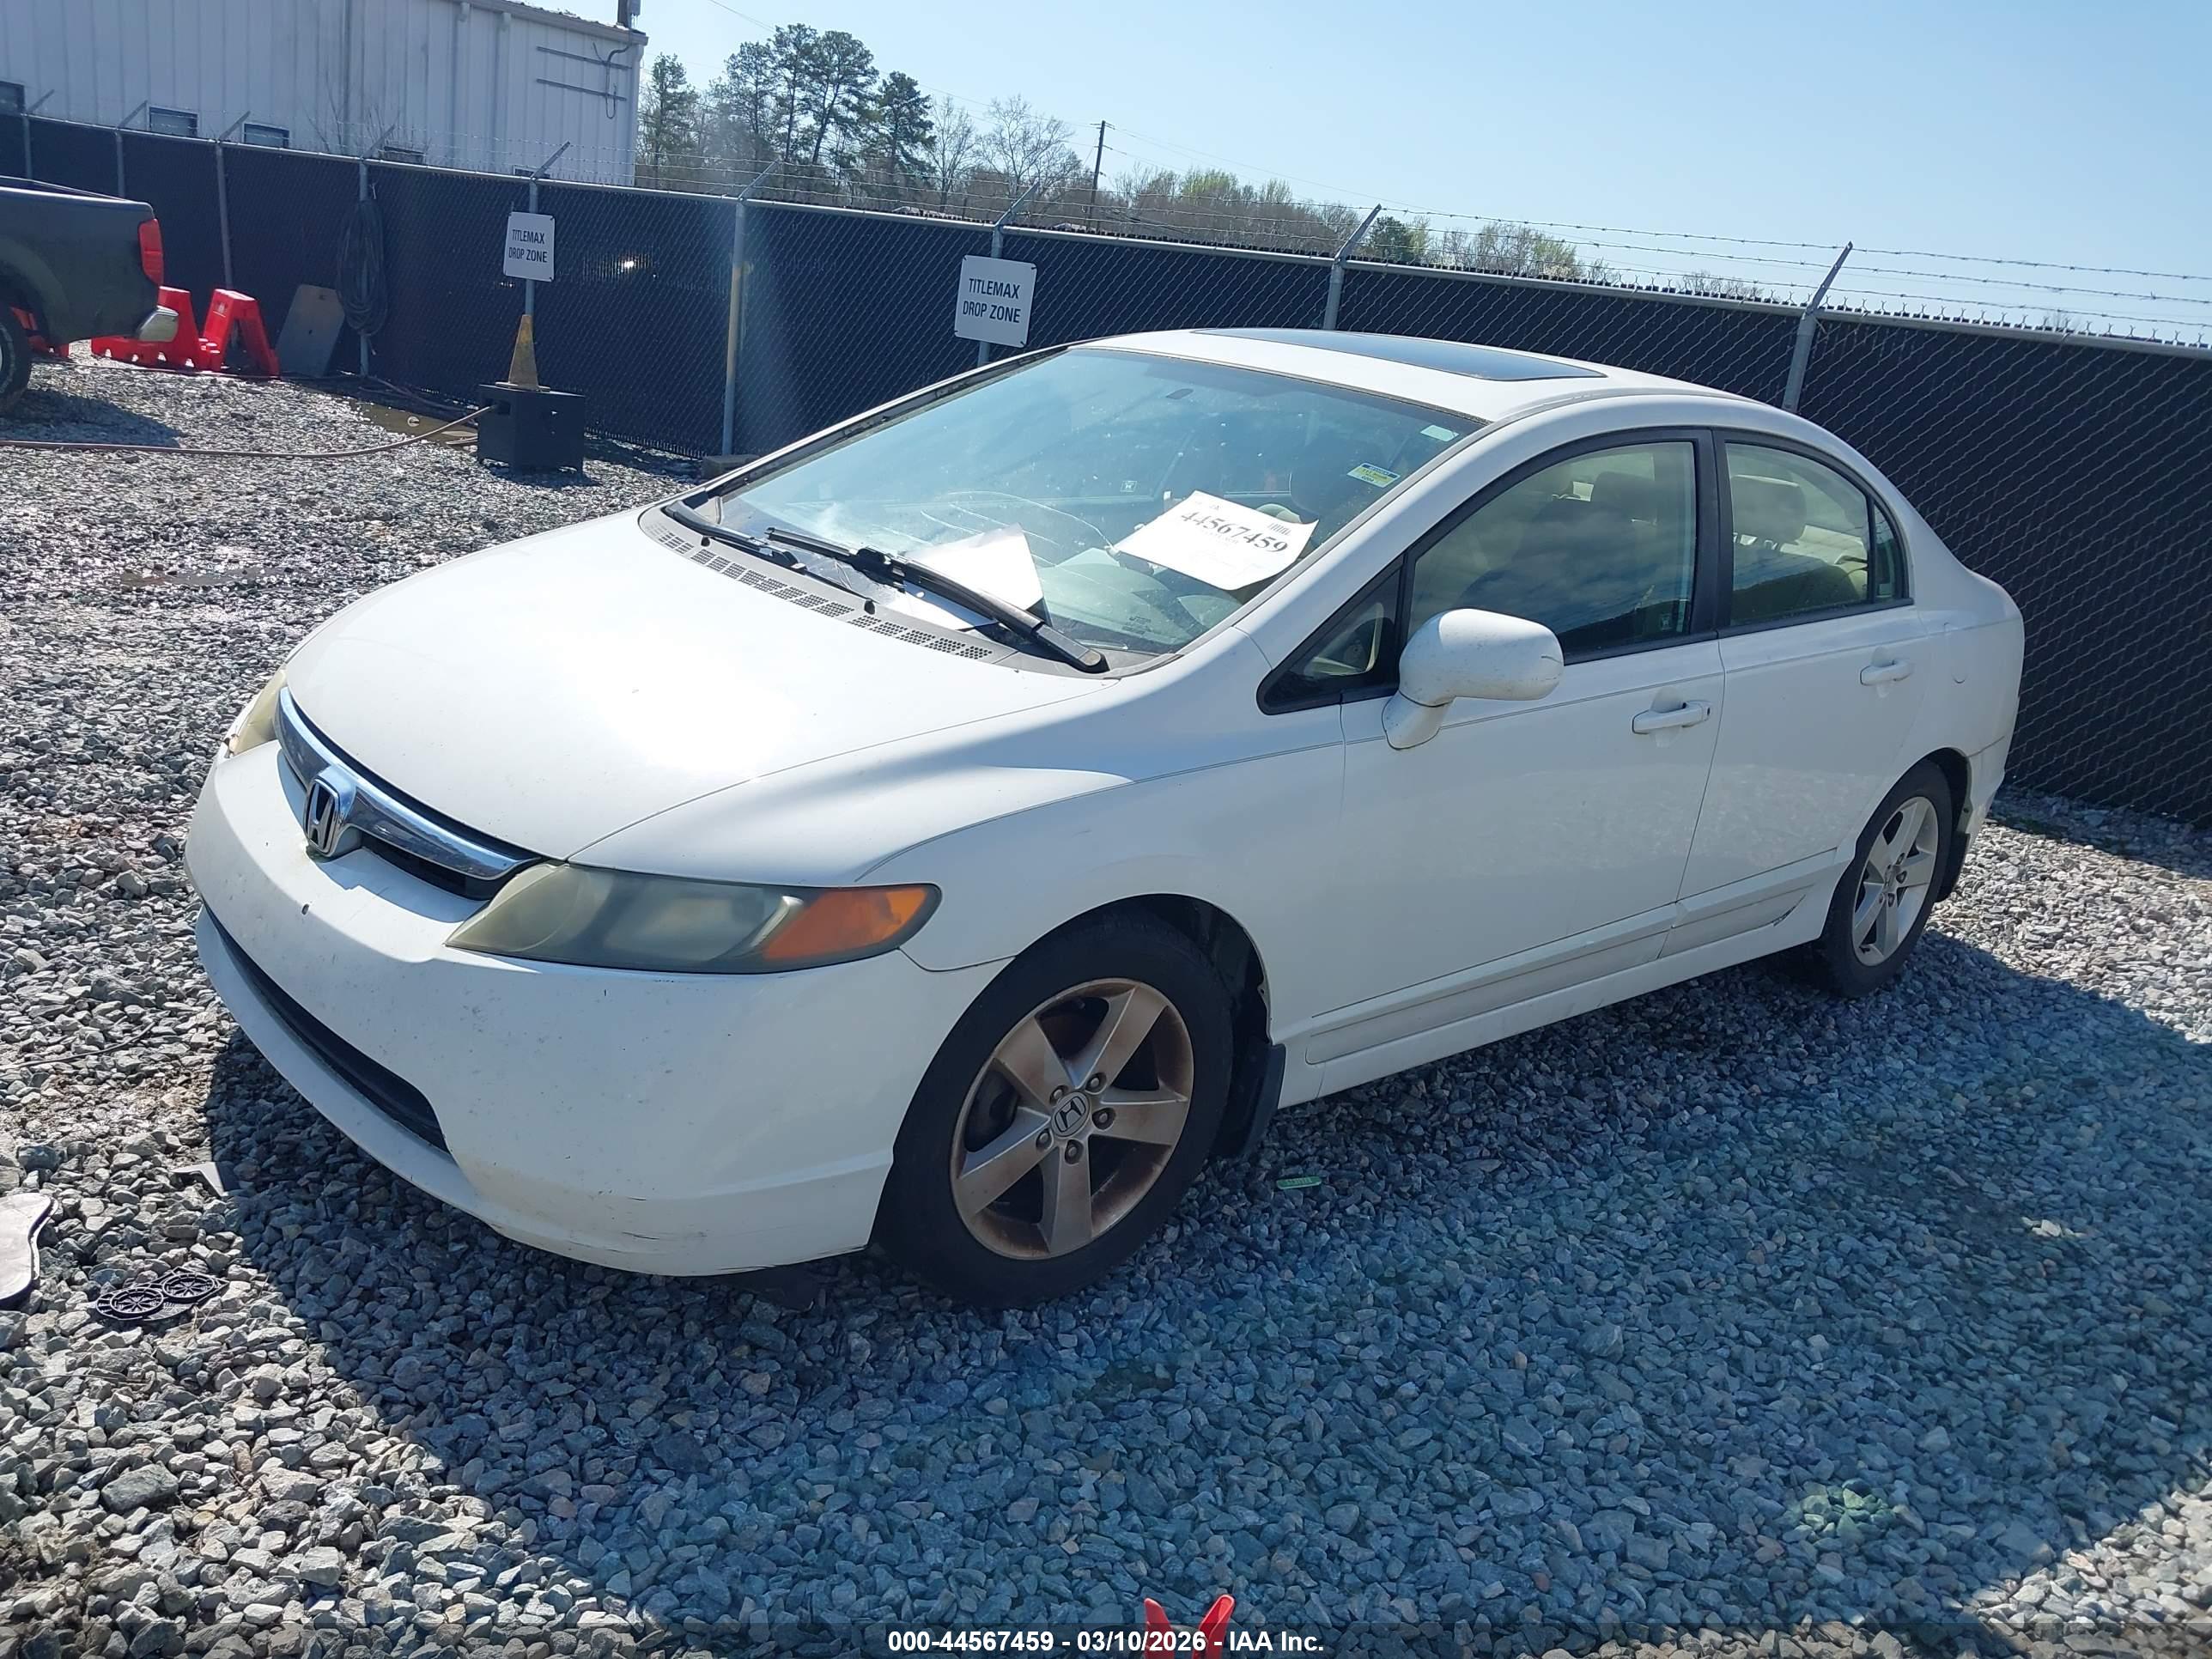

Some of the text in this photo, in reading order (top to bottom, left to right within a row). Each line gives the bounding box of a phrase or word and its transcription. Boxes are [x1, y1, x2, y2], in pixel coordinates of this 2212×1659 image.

[512, 228, 545, 245] TITLEMAX
[508, 246, 548, 263] DROP ZONE
[969, 277, 1020, 300] TITLEMAX
[963, 301, 1022, 324] DROP ZONE
[1181, 511, 1289, 553] 44567459
